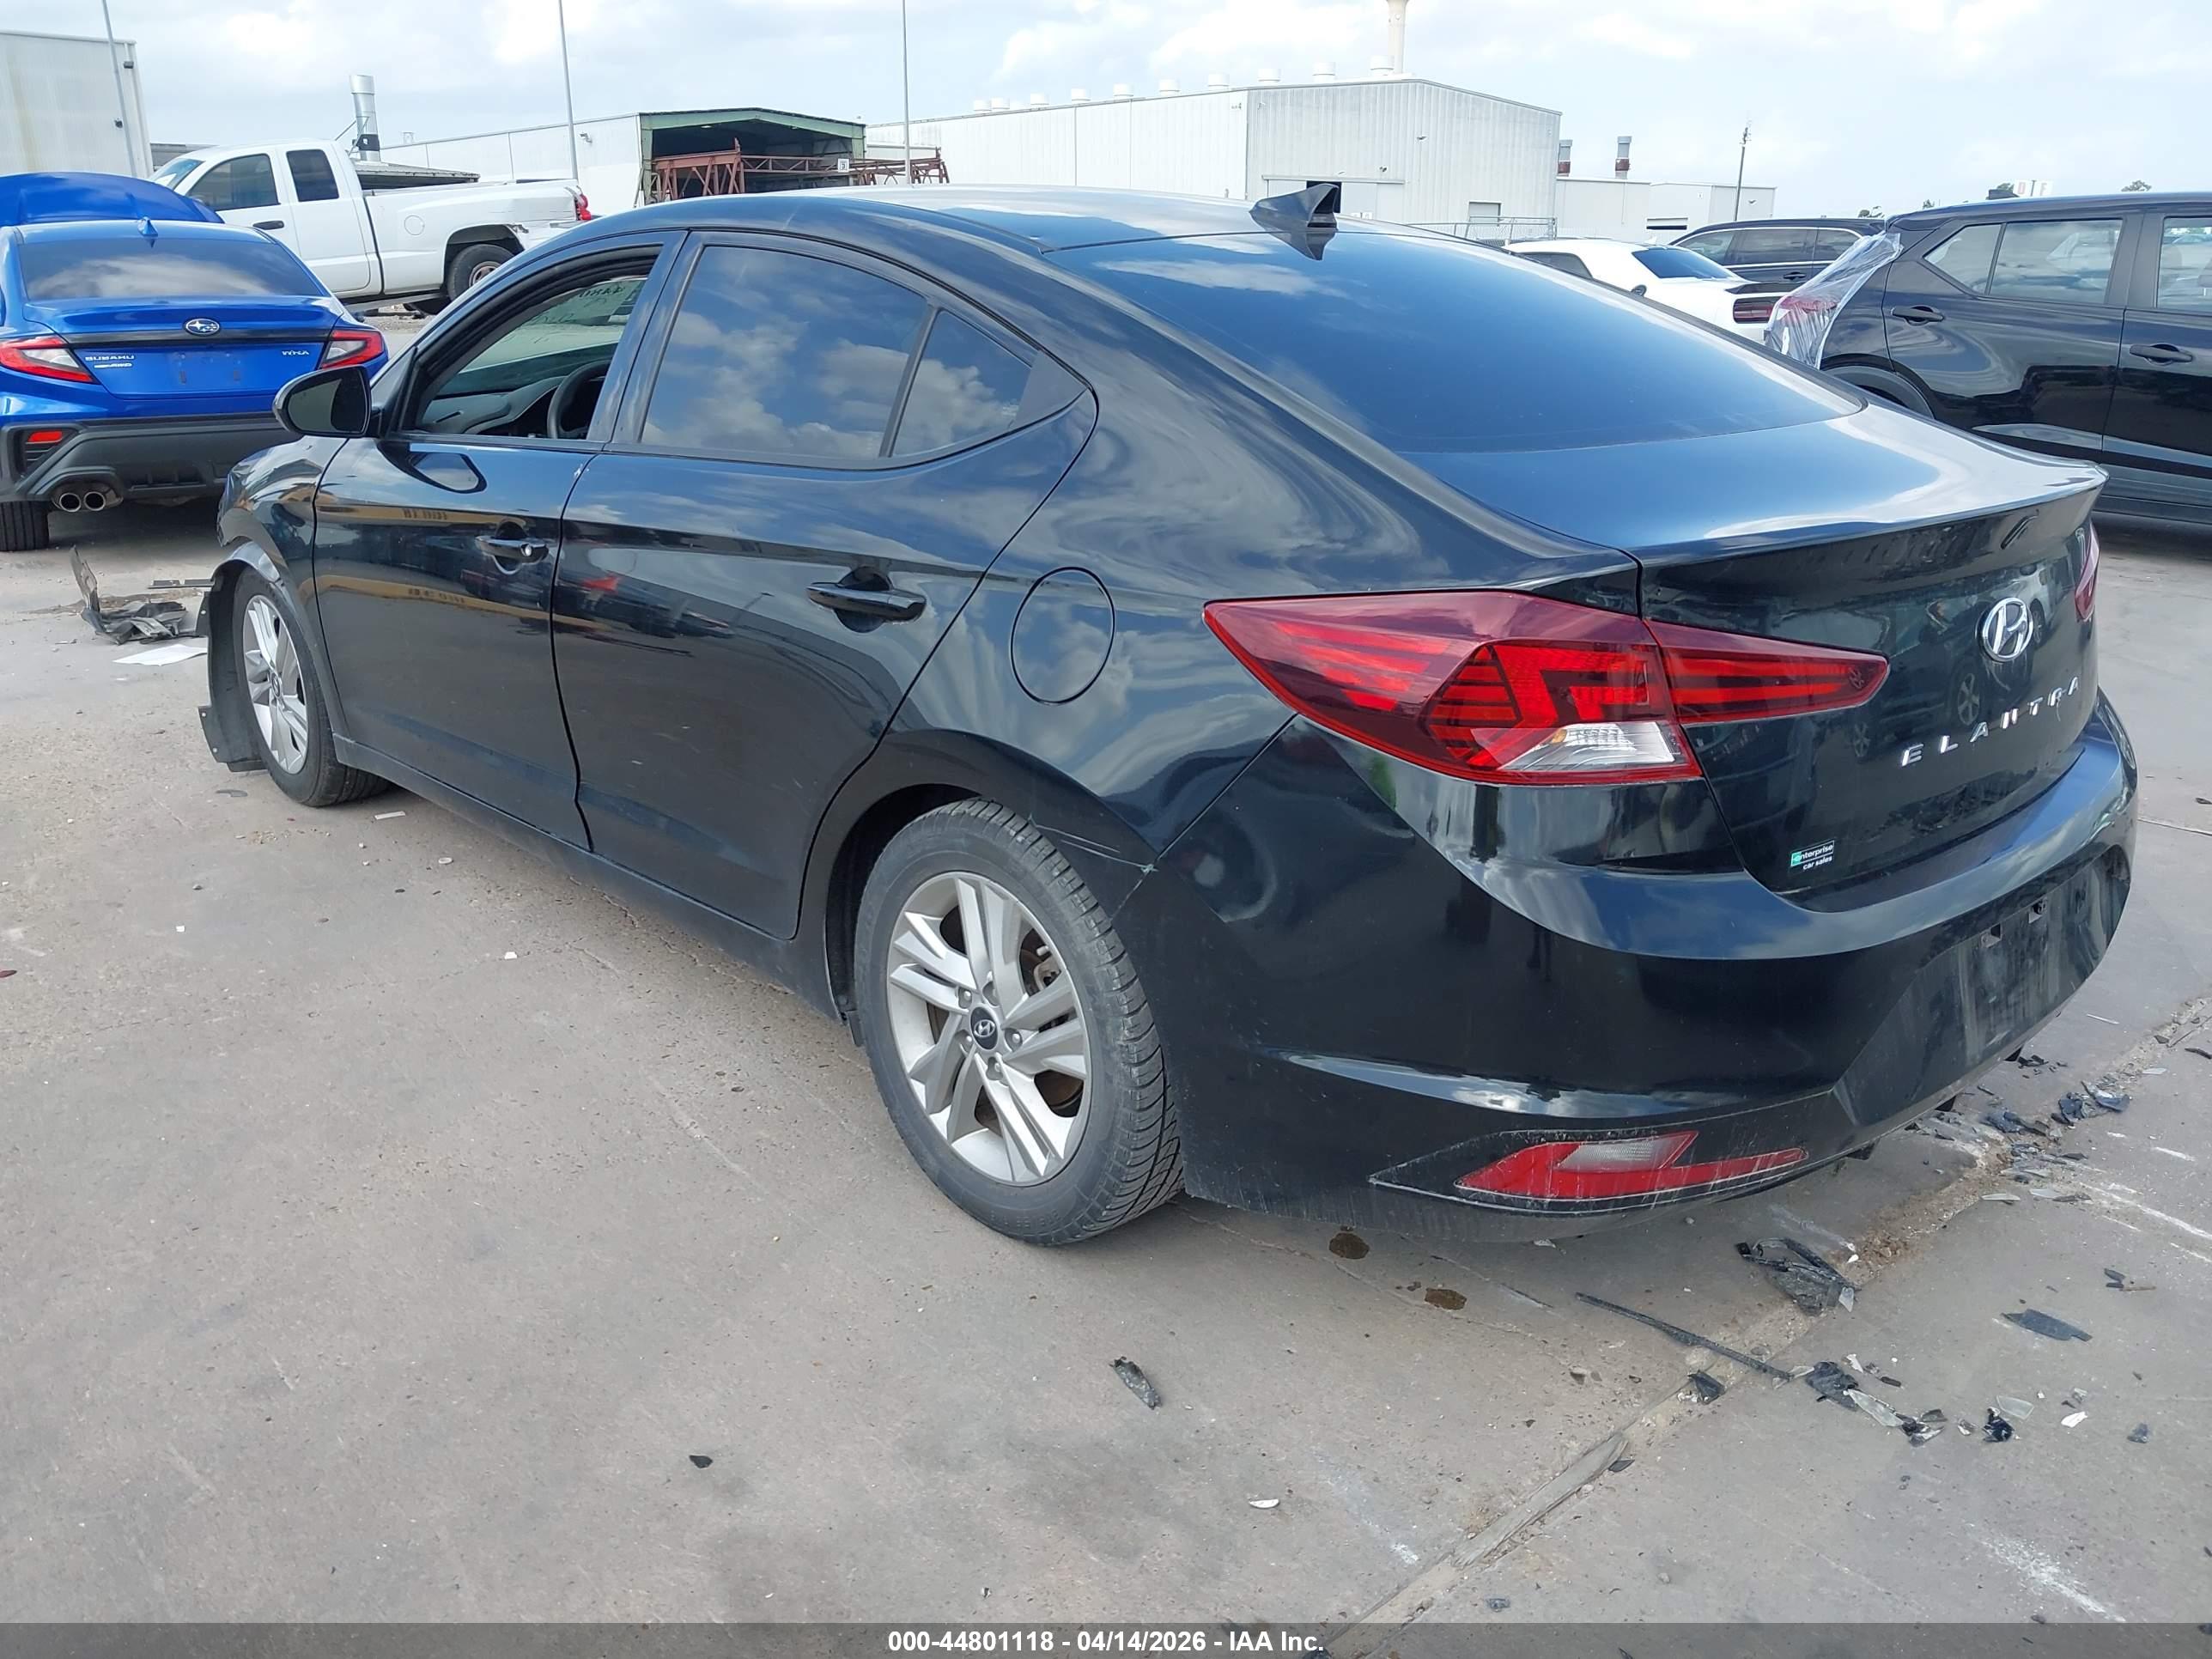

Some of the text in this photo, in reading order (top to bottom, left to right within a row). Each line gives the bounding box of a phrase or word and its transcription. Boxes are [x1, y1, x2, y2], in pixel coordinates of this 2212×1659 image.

[1900, 675, 2081, 767] ELANTRA
[1792, 844, 1833, 861] enterprise
[1802, 855, 1833, 871] car sales
